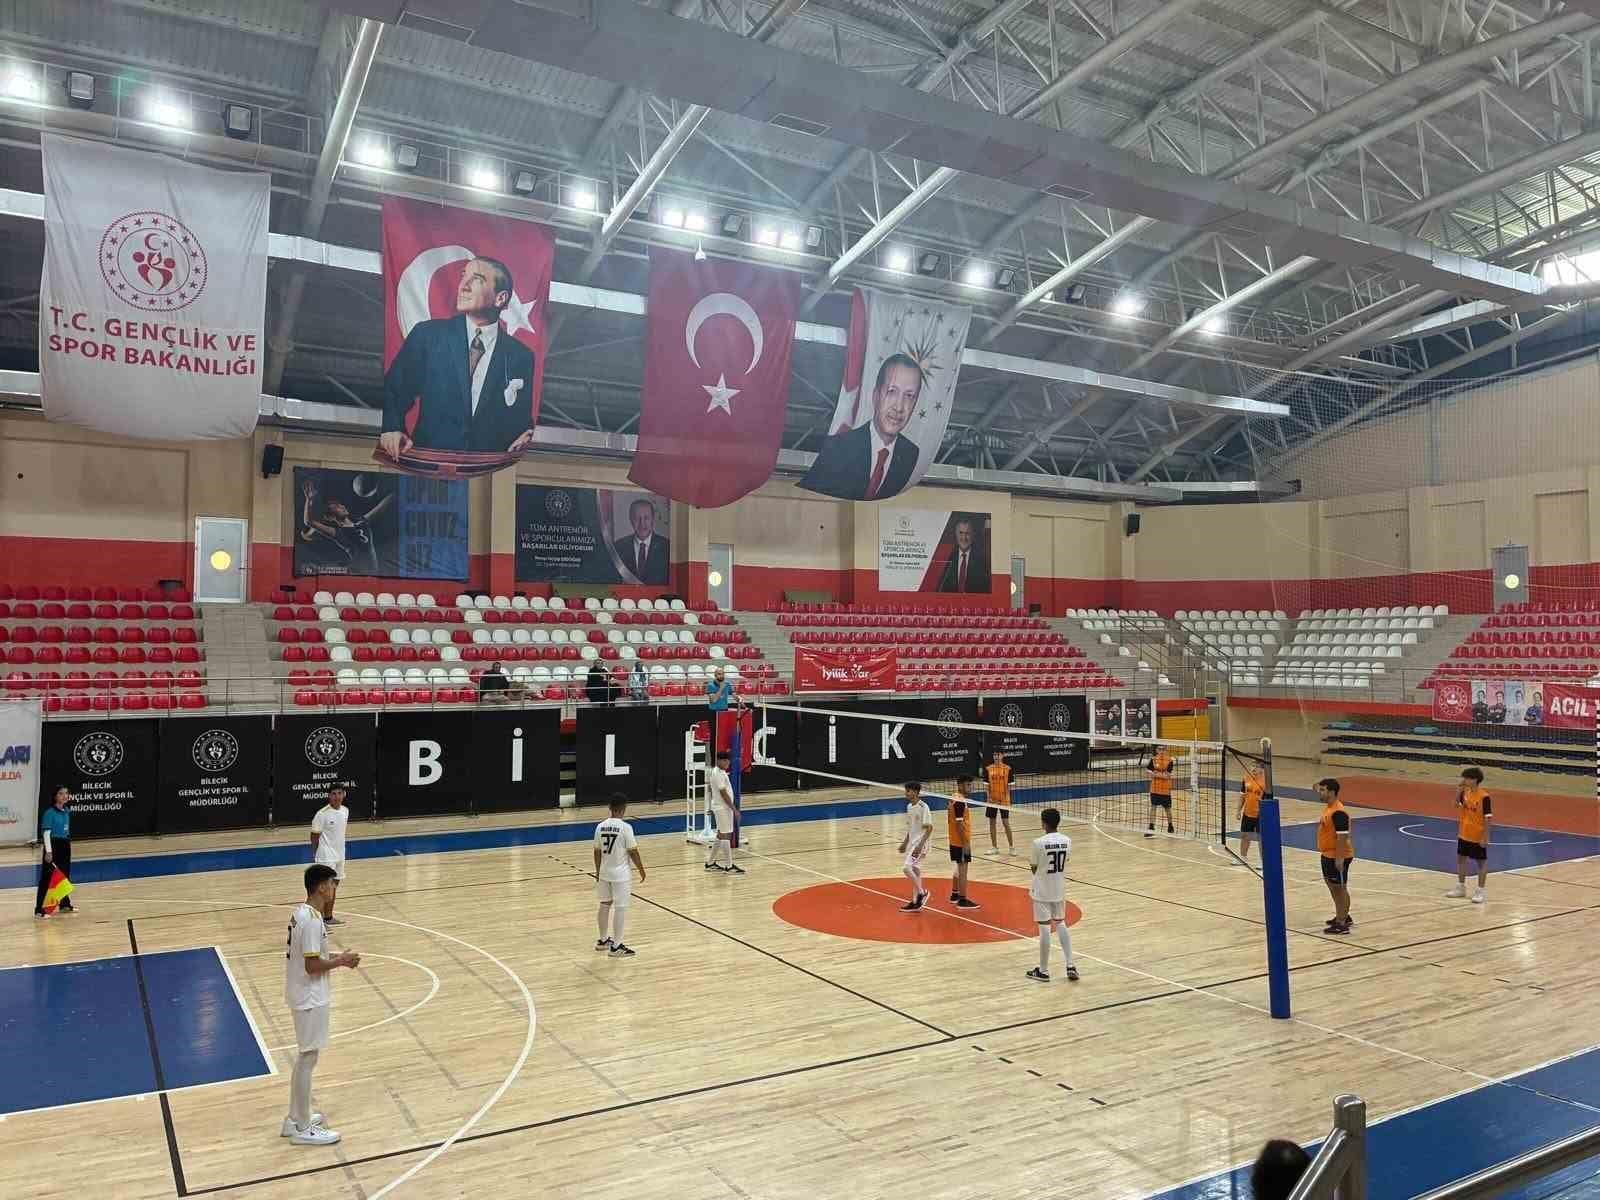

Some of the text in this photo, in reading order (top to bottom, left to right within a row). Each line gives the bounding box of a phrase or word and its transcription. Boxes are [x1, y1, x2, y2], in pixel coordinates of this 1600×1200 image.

[50, 306, 256, 352] T.C. GENÇLİK VE
[49, 334, 255, 376] SPOR BAKANLIĞI
[200, 777, 228, 785] BİLECİK
[312, 771, 338, 780] BİLECİK
[82, 781, 112, 790] BİLECİK
[68, 792, 92, 803] NÇLİK
[105, 792, 126, 800] SPOR
[178, 787, 210, 798] GENÇLİK
[211, 787, 221, 795] VE
[222, 787, 242, 795] SPOR
[600, 833, 618, 855] 37
[1047, 850, 1067, 874] 30
